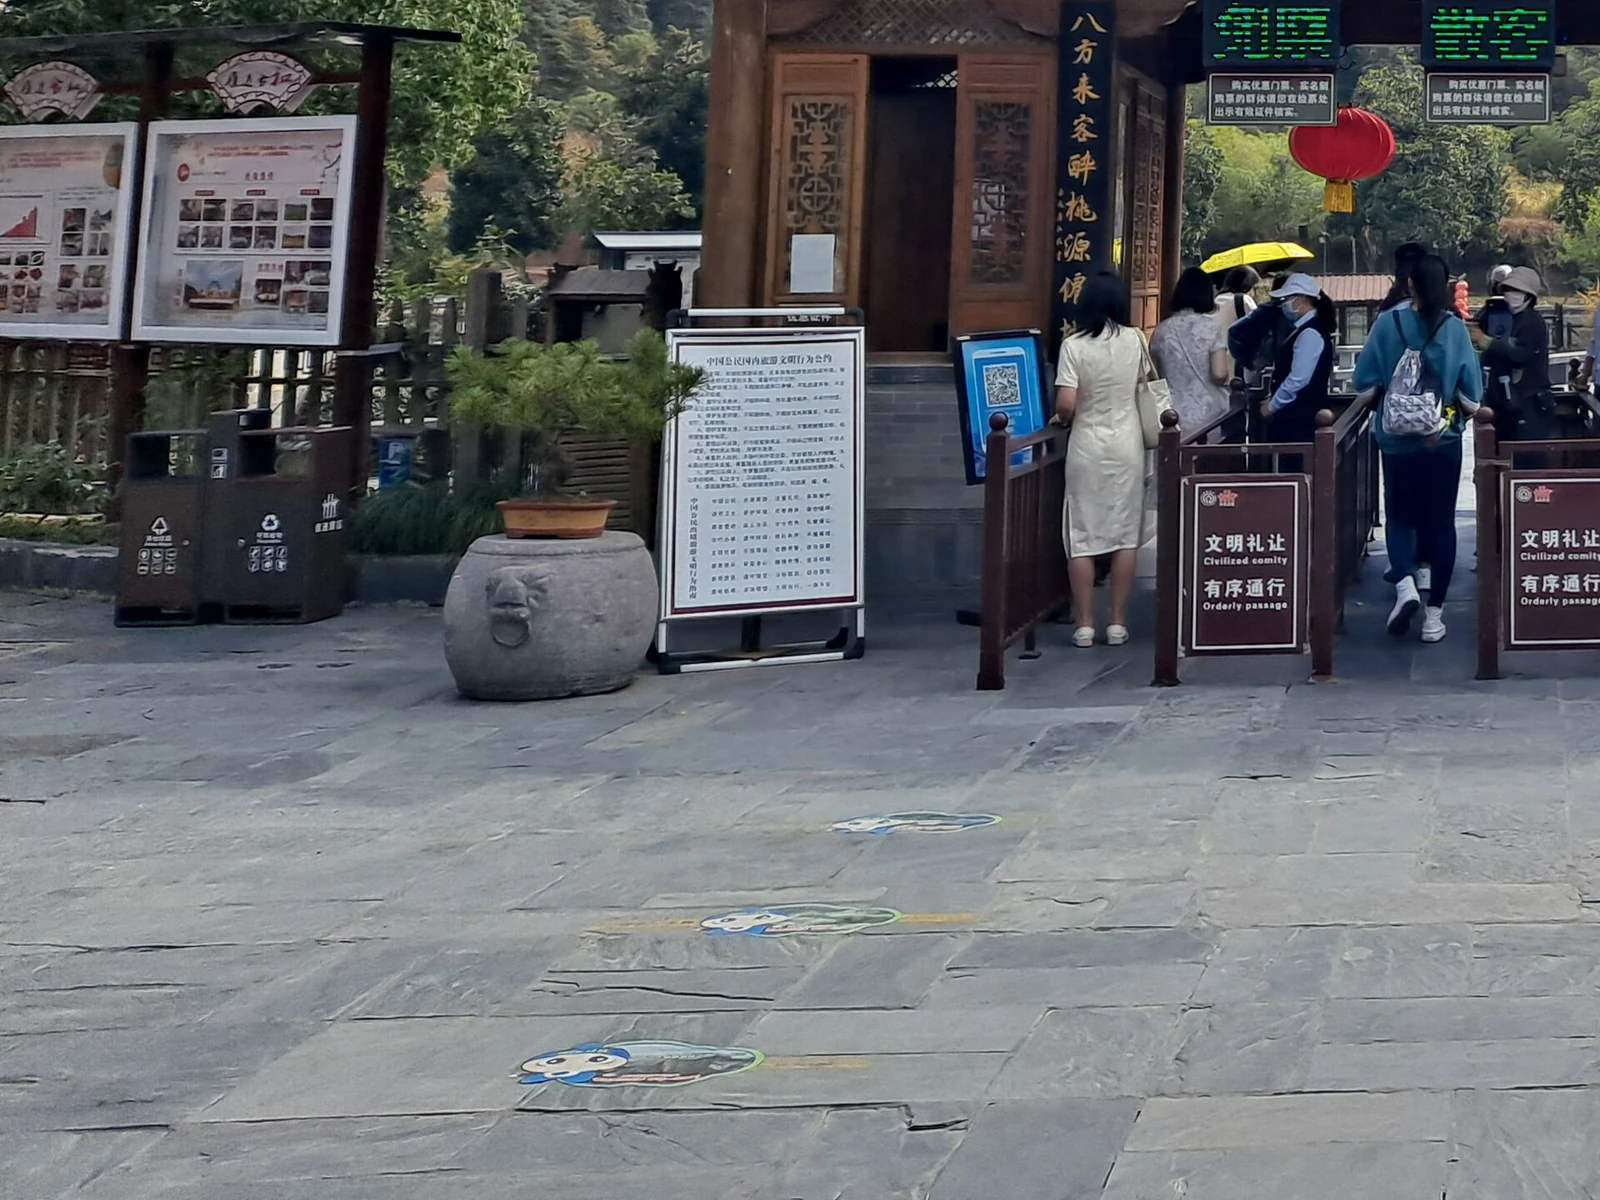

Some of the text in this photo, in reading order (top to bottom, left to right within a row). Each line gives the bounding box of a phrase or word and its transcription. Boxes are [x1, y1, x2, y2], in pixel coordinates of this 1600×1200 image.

[1430, 8, 1549, 60] 散客
[1204, 533, 1287, 553] 文明礼让
[1520, 529, 1600, 549] 文明礼让
[1203, 555, 1289, 566] Civilized comity
[1520, 552, 1566, 561] Civilized
[1203, 578, 1286, 599] 有序通行
[1203, 601, 1288, 612] Orderly passage
[1520, 597, 1559, 607] Orderly
